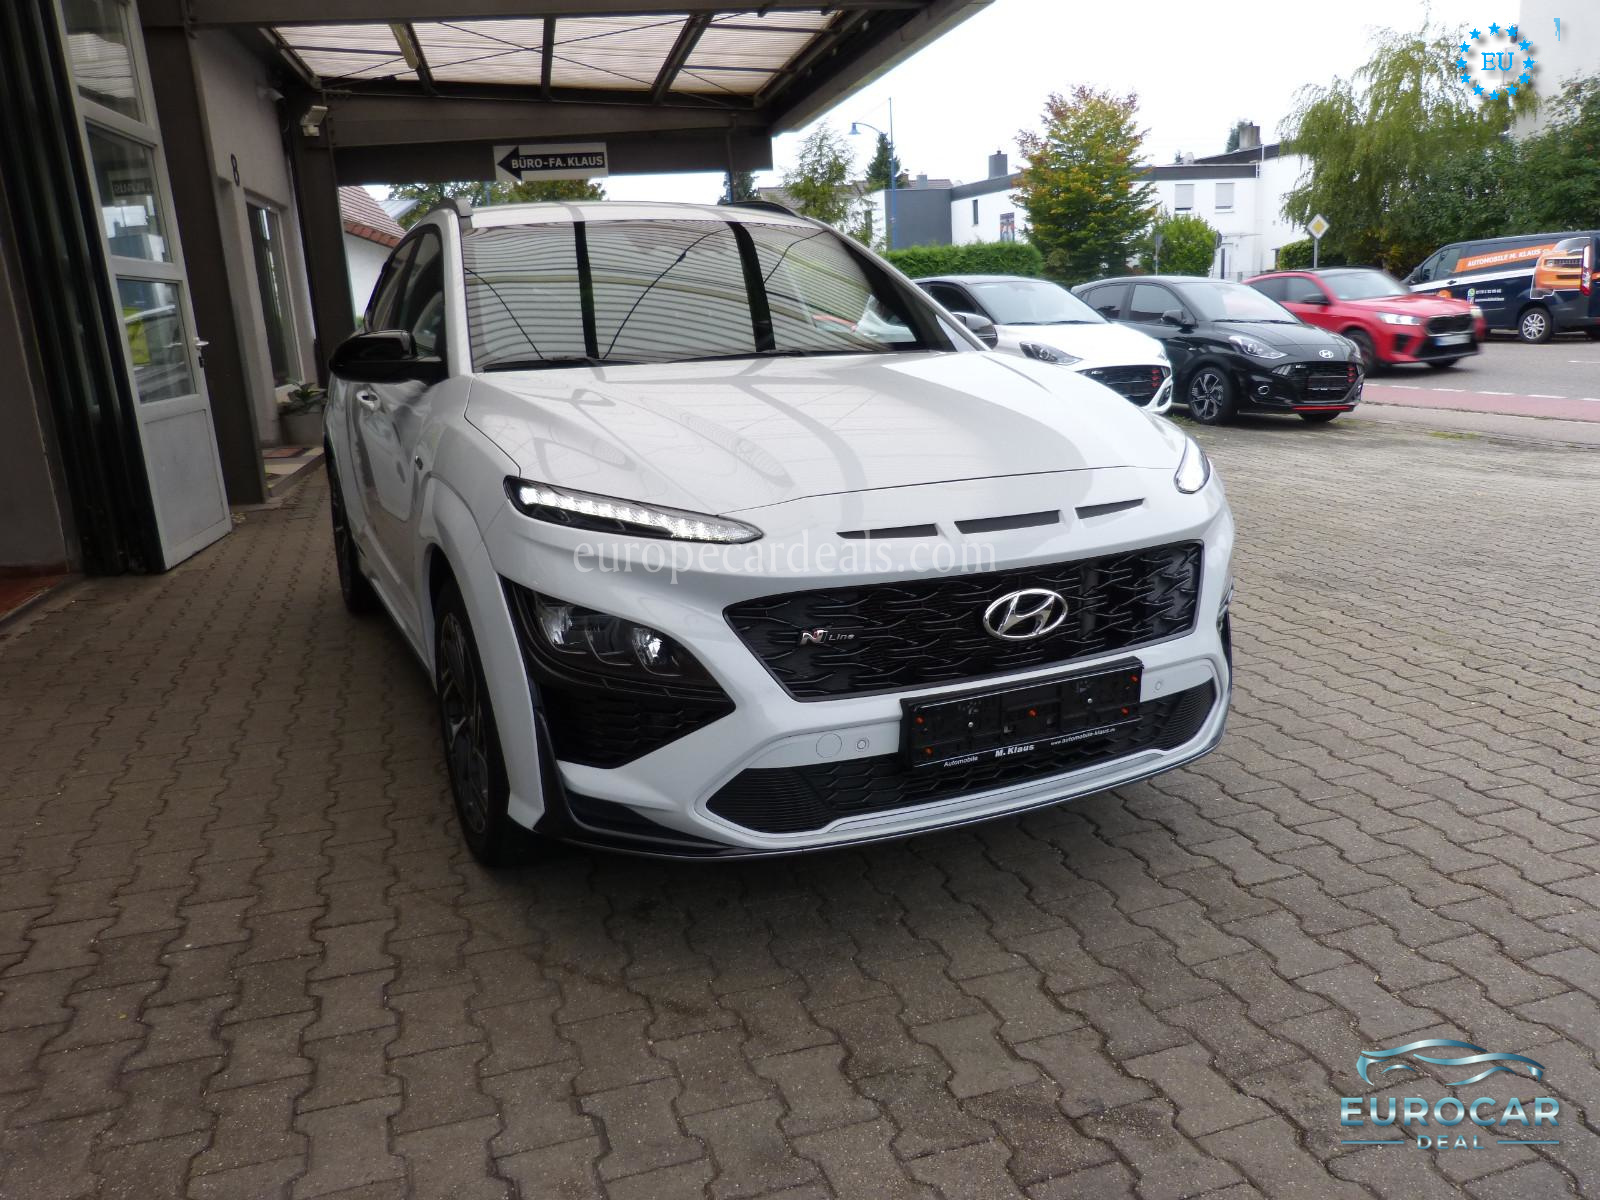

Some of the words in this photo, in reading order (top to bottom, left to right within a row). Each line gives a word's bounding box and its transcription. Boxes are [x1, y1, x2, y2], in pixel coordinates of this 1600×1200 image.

[230, 153, 240, 186] 8
[568, 156, 603, 167] KLAUS
[1467, 253, 1508, 267] AUTOMOBILE
[1518, 248, 1541, 258] KLAUS
[944, 755, 978, 767] Automobile
[995, 749, 1007, 757] M.
[1007, 743, 1035, 755] Klaus
